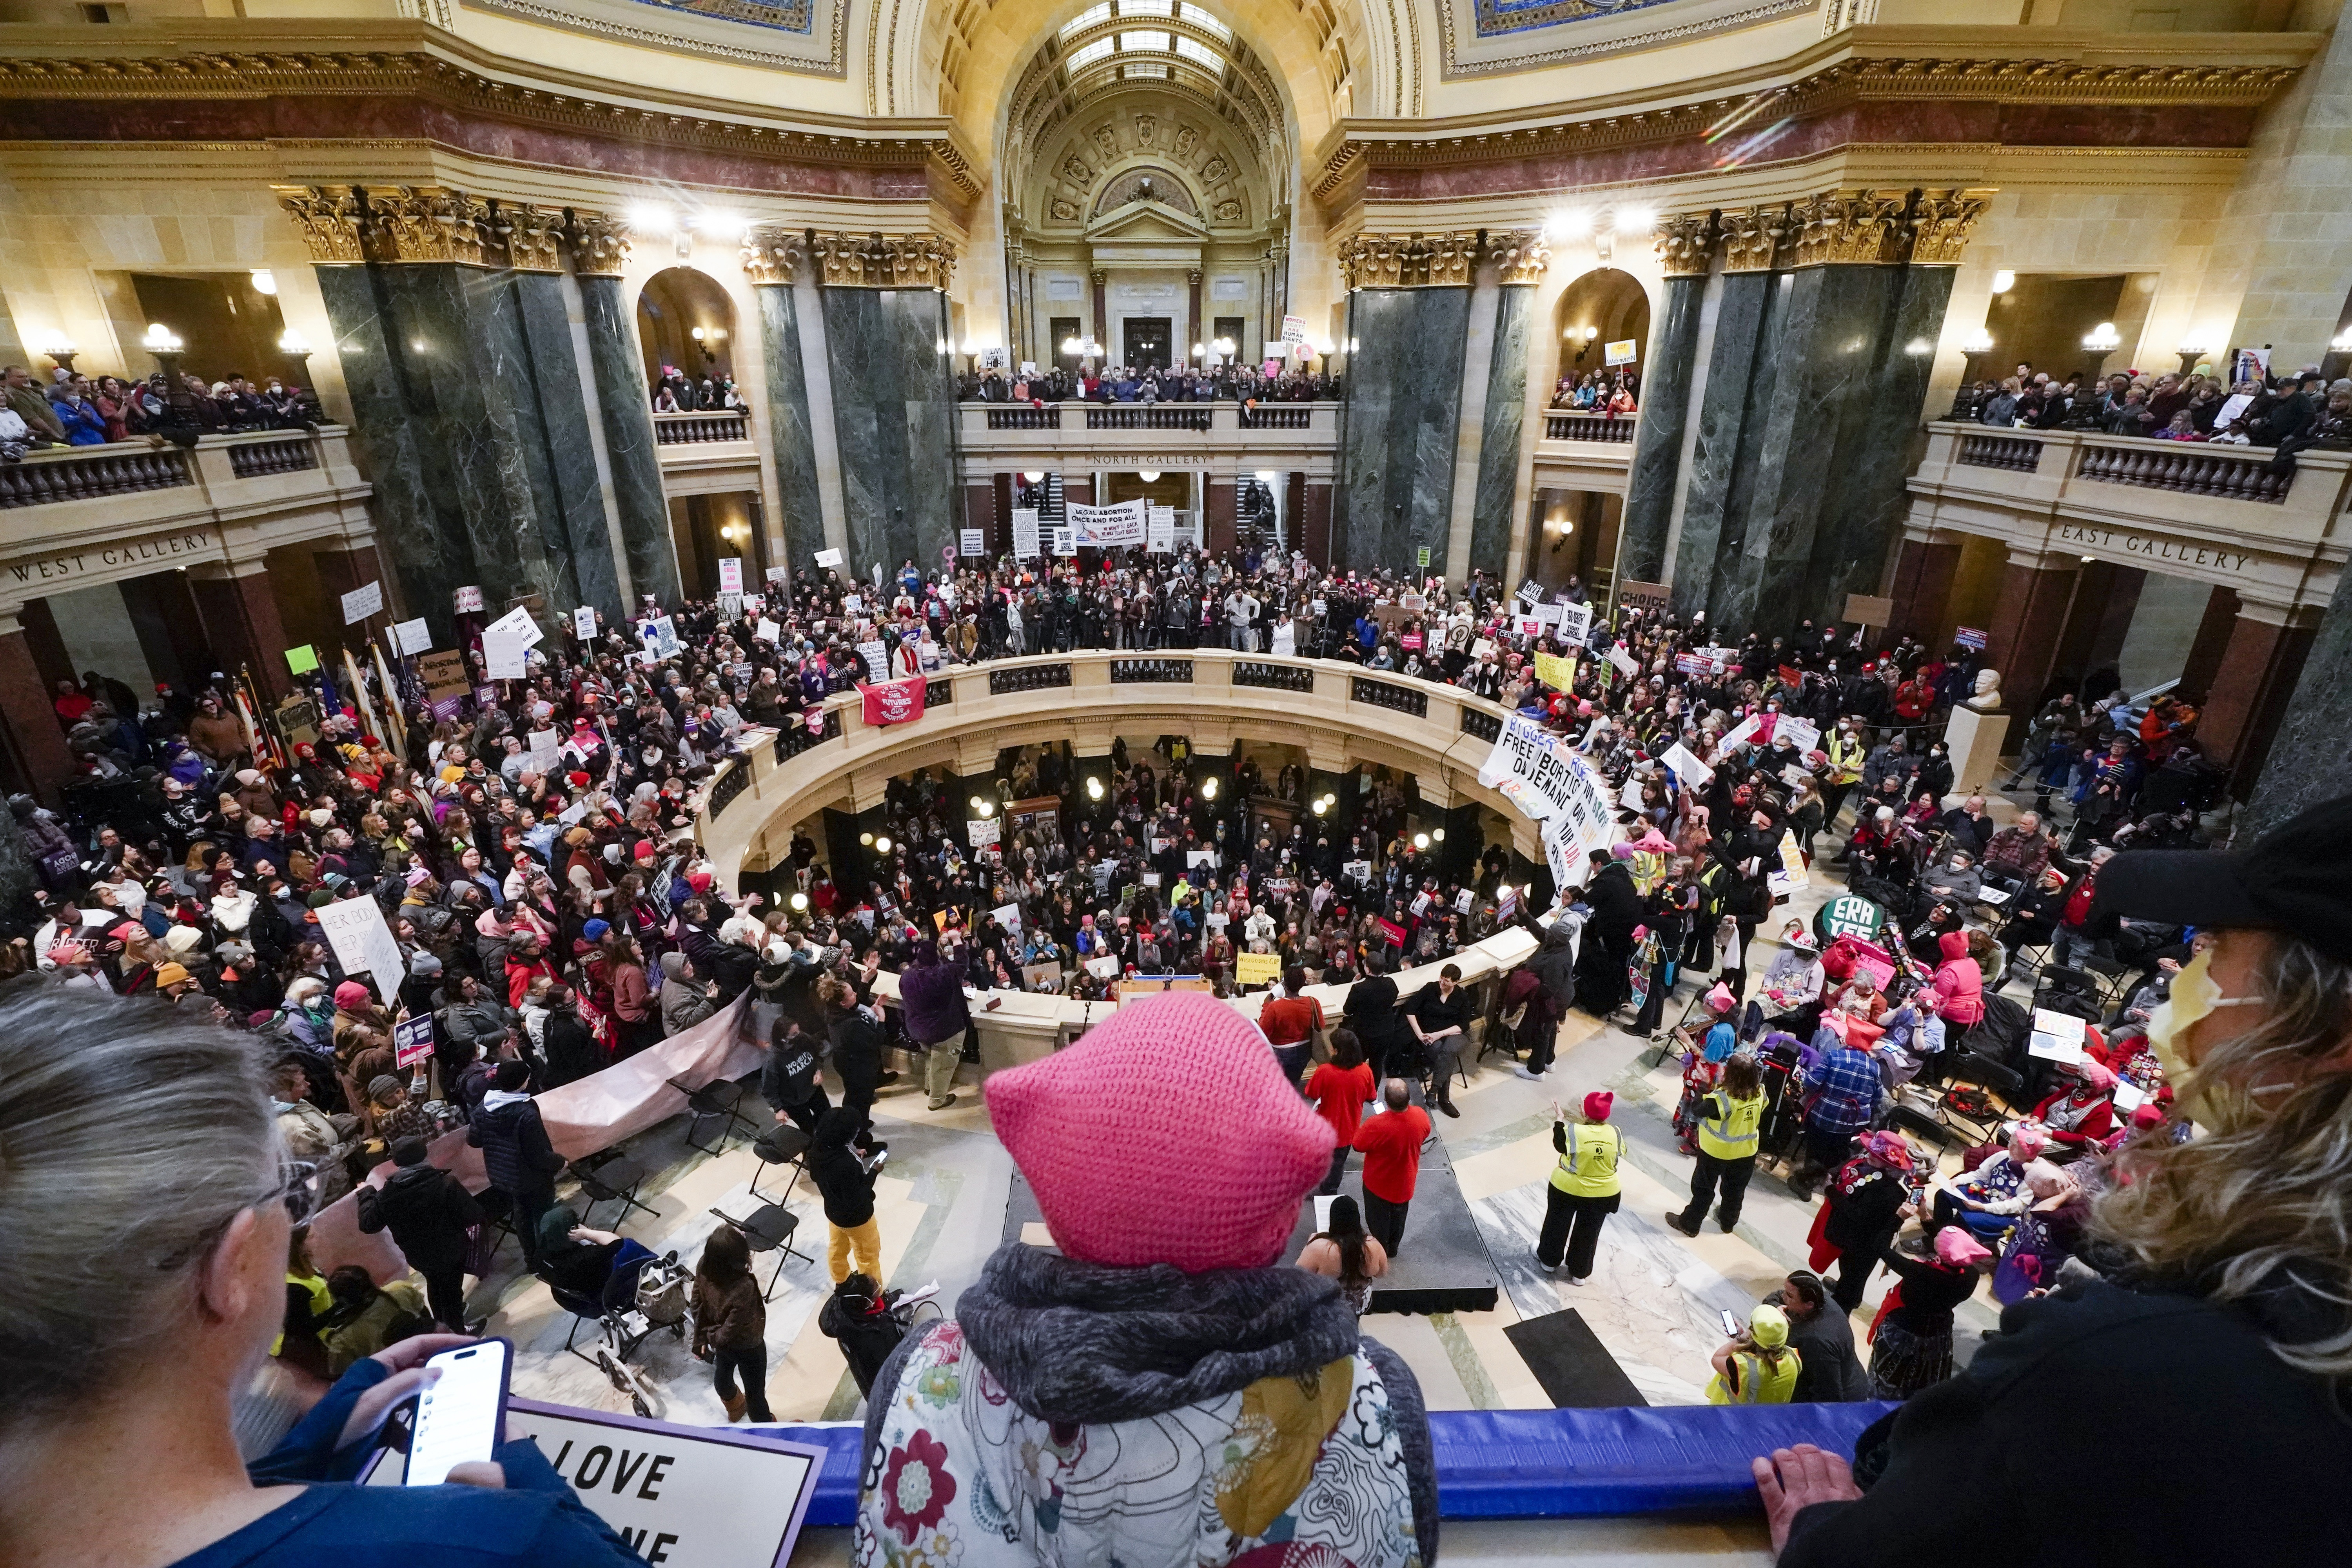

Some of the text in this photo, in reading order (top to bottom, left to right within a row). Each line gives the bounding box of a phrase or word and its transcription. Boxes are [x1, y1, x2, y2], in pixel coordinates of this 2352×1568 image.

[1285, 321, 1305, 330] RIGHTS
[1093, 455, 1208, 465] NORTH GALLERY
[2061, 524, 2250, 572] EAST GALLERY
[9, 532, 209, 582] WEST GALLERY
[1524, 584, 1542, 596] LIVES
[1528, 580, 1544, 592] BLACK
[1521, 588, 1539, 602] MATTER.
[1620, 592, 1666, 606] CHOICE
[512, 614, 525, 624] YOUR
[523, 629, 536, 642] BODY!
[423, 656, 463, 671] ABORTION
[733, 662, 751, 671] BORTION
[1677, 659, 1710, 670] REPRODUCTIVE
[438, 668, 449, 678] IS
[1676, 666, 1708, 676] FREEDOM!
[480, 688, 494, 696] EVERY
[889, 684, 910, 694] BODIES
[481, 693, 495, 702] BODY
[880, 709, 910, 721] ABORTIONS
[1510, 716, 1592, 781] BIGGER ROE
[1503, 732, 1581, 794] FREE BORTIO
[1783, 837, 1807, 882] HANDS
[655, 873, 666, 885] BODY
[659, 882, 669, 894] RIGHTS
[1833, 897, 1875, 925] ERA
[325, 906, 375, 932] HER BODY
[336, 933, 357, 954] HER
[1845, 934, 1862, 943] STAND
[1862, 941, 1875, 949] WITH
[346, 956, 367, 974] HER
[1238, 955, 1269, 964] Wisconsins
[579, 998, 601, 1016] BANS
[414, 1021, 431, 1033] WOMEN'S
[2037, 1011, 2083, 1029] GRAN
[417, 1029, 430, 1040] RIGHTS
[2039, 1022, 2081, 1038] NIES
[400, 1051, 417, 1065] HUMAN
[785, 1051, 810, 1070] WOMEN'S
[788, 1054, 814, 1077] MARCH
[552, 1440, 675, 1501] LOVE
